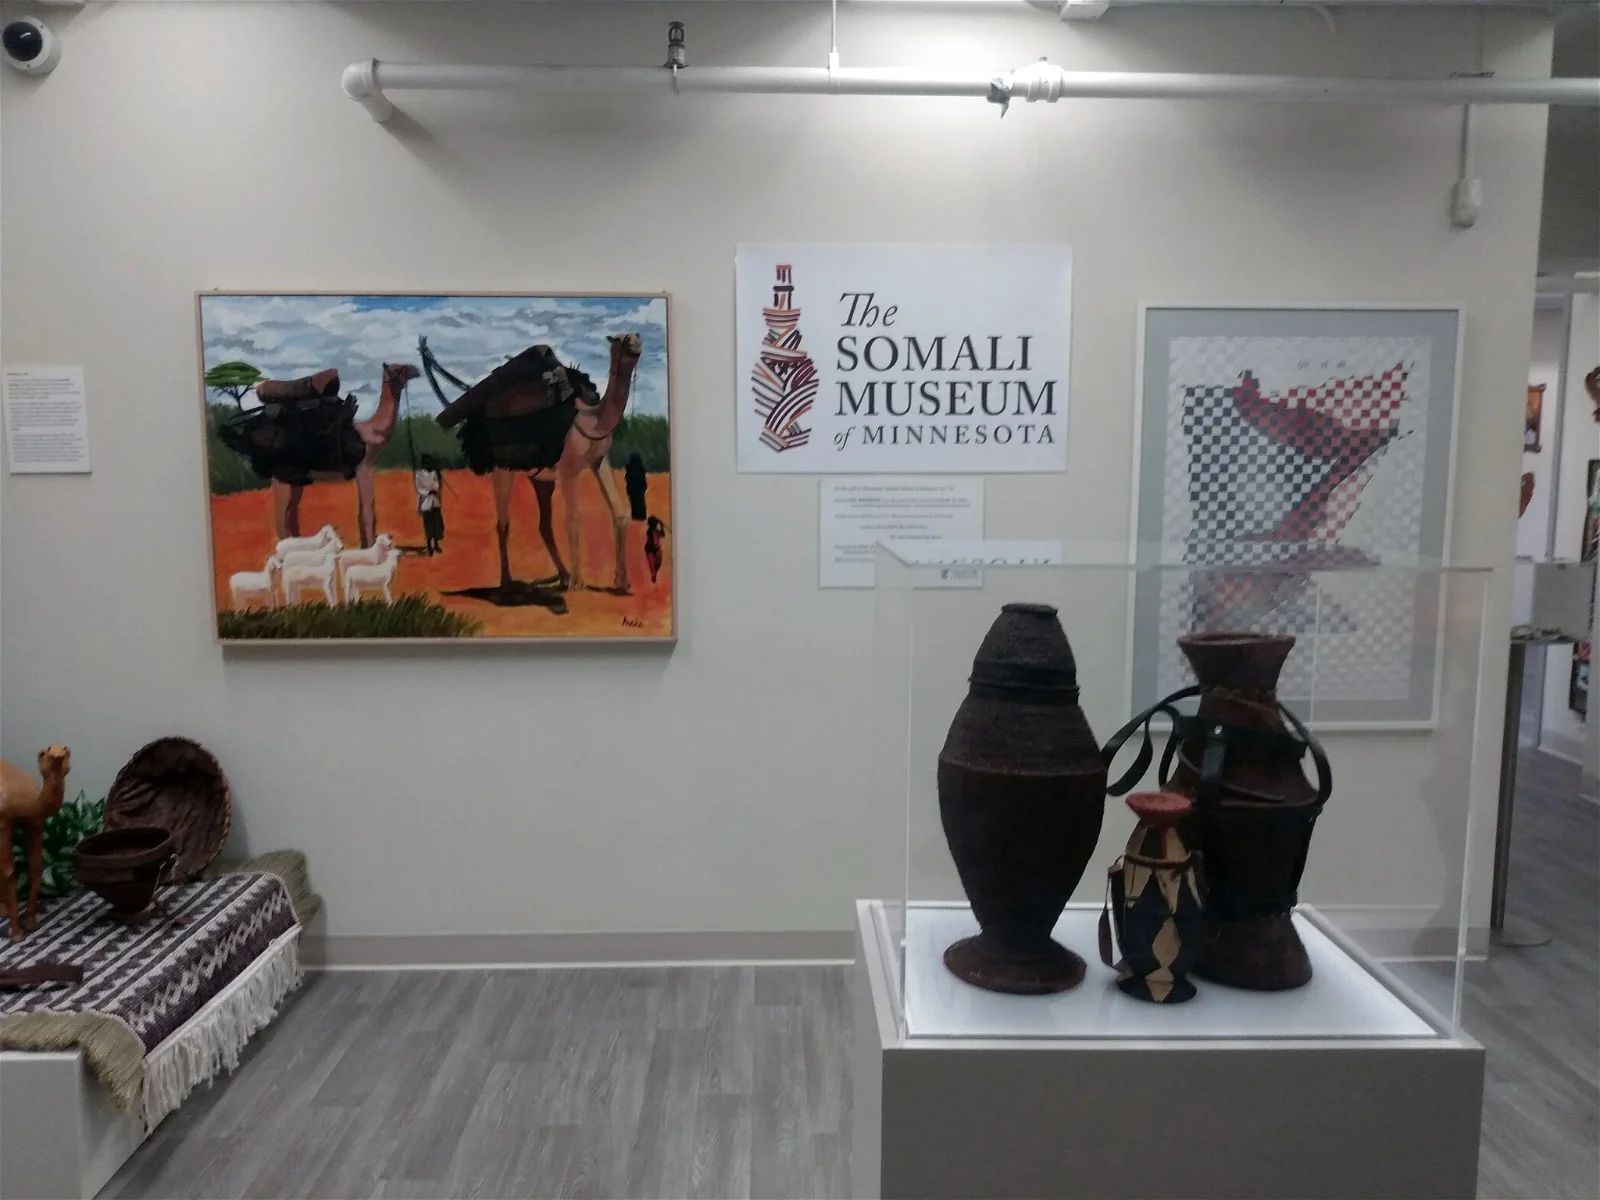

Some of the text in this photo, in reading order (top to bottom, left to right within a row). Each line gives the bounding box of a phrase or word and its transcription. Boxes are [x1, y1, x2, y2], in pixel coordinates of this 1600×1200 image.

[839, 292, 898, 328] The
[836, 334, 1033, 372] SOMALI
[834, 380, 1058, 416] MUSEUM
[833, 425, 1056, 452] of MINNESOTA
